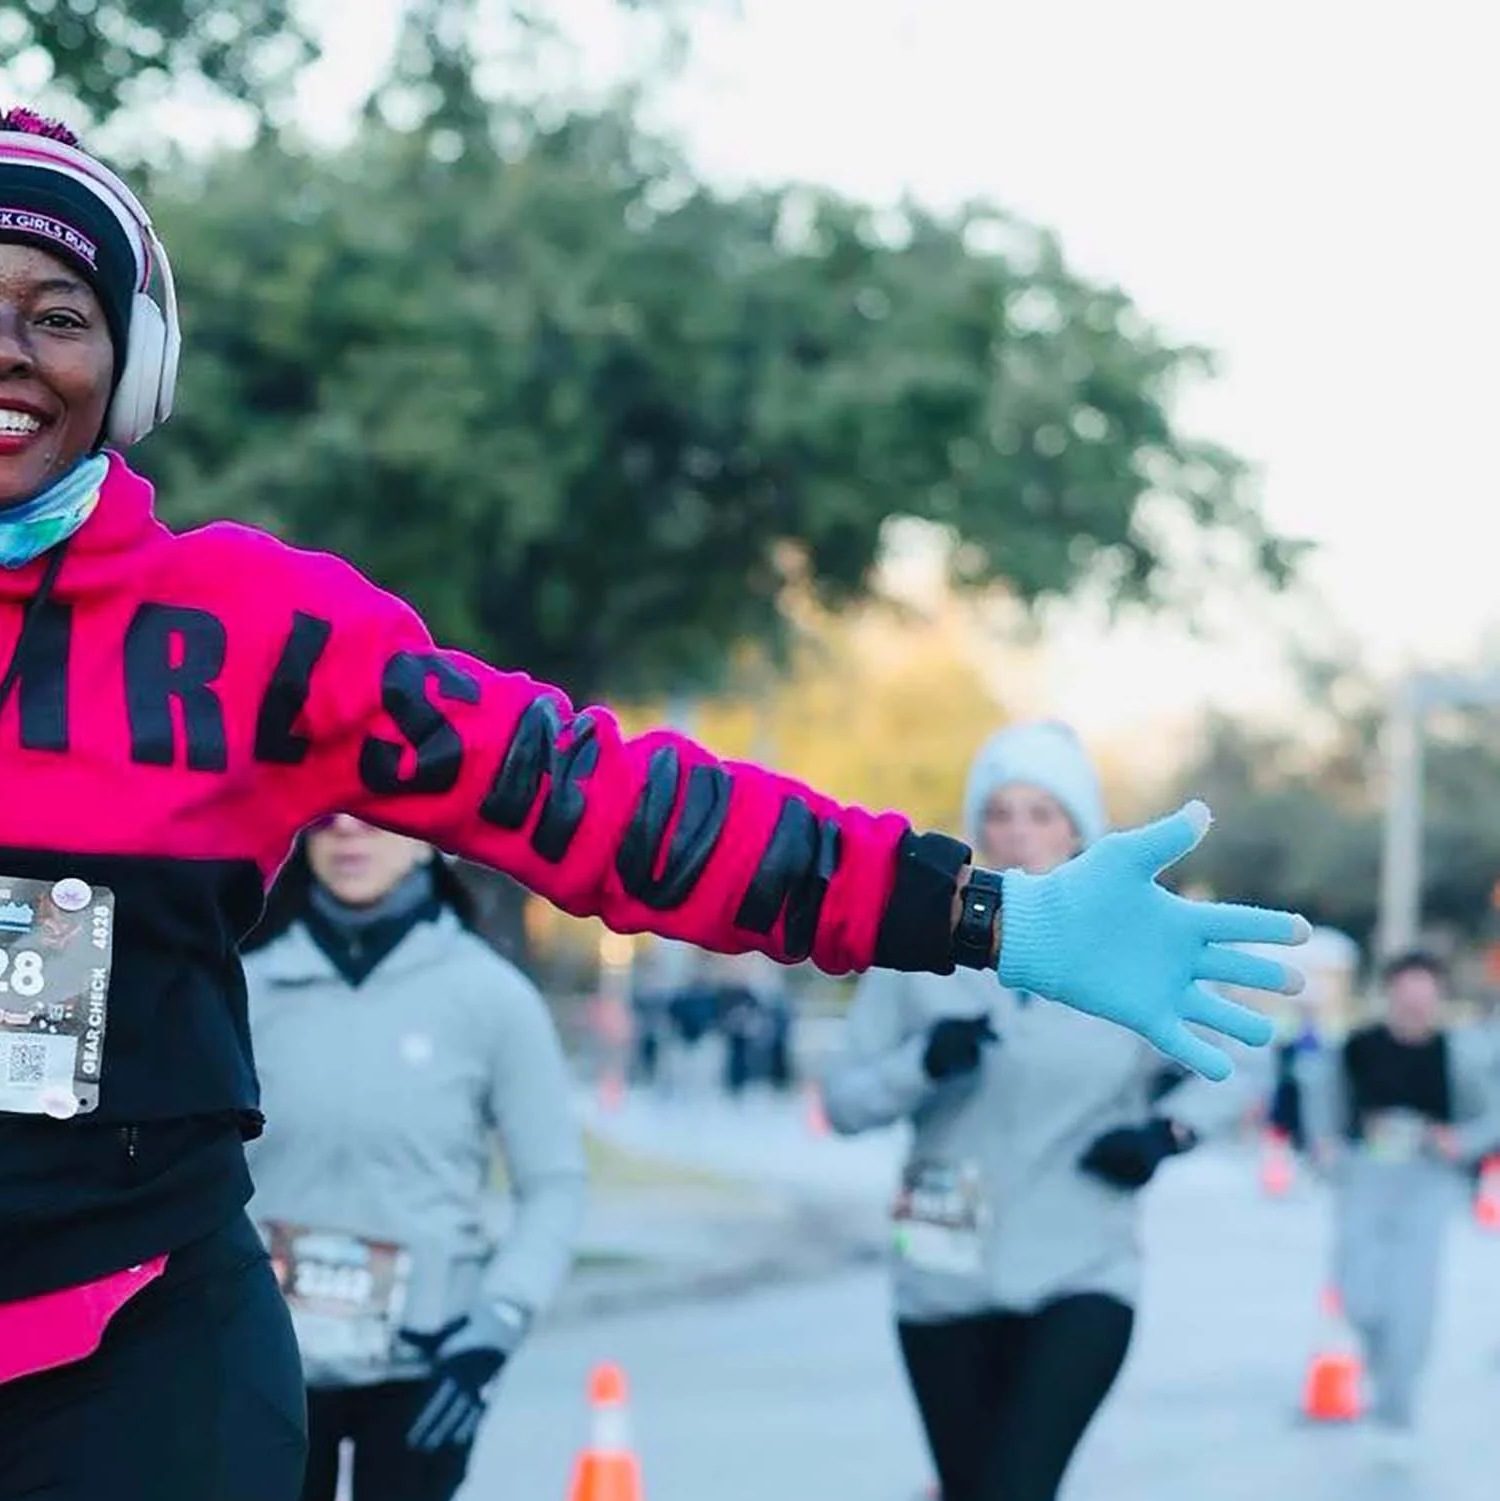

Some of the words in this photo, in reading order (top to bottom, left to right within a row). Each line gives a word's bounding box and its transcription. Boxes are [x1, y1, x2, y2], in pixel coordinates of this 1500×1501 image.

[16, 215, 63, 239] GIRLS
[92, 905, 110, 951] 4828
[88, 967, 107, 1026] CHECK
[82, 1027, 101, 1075] GEAR
